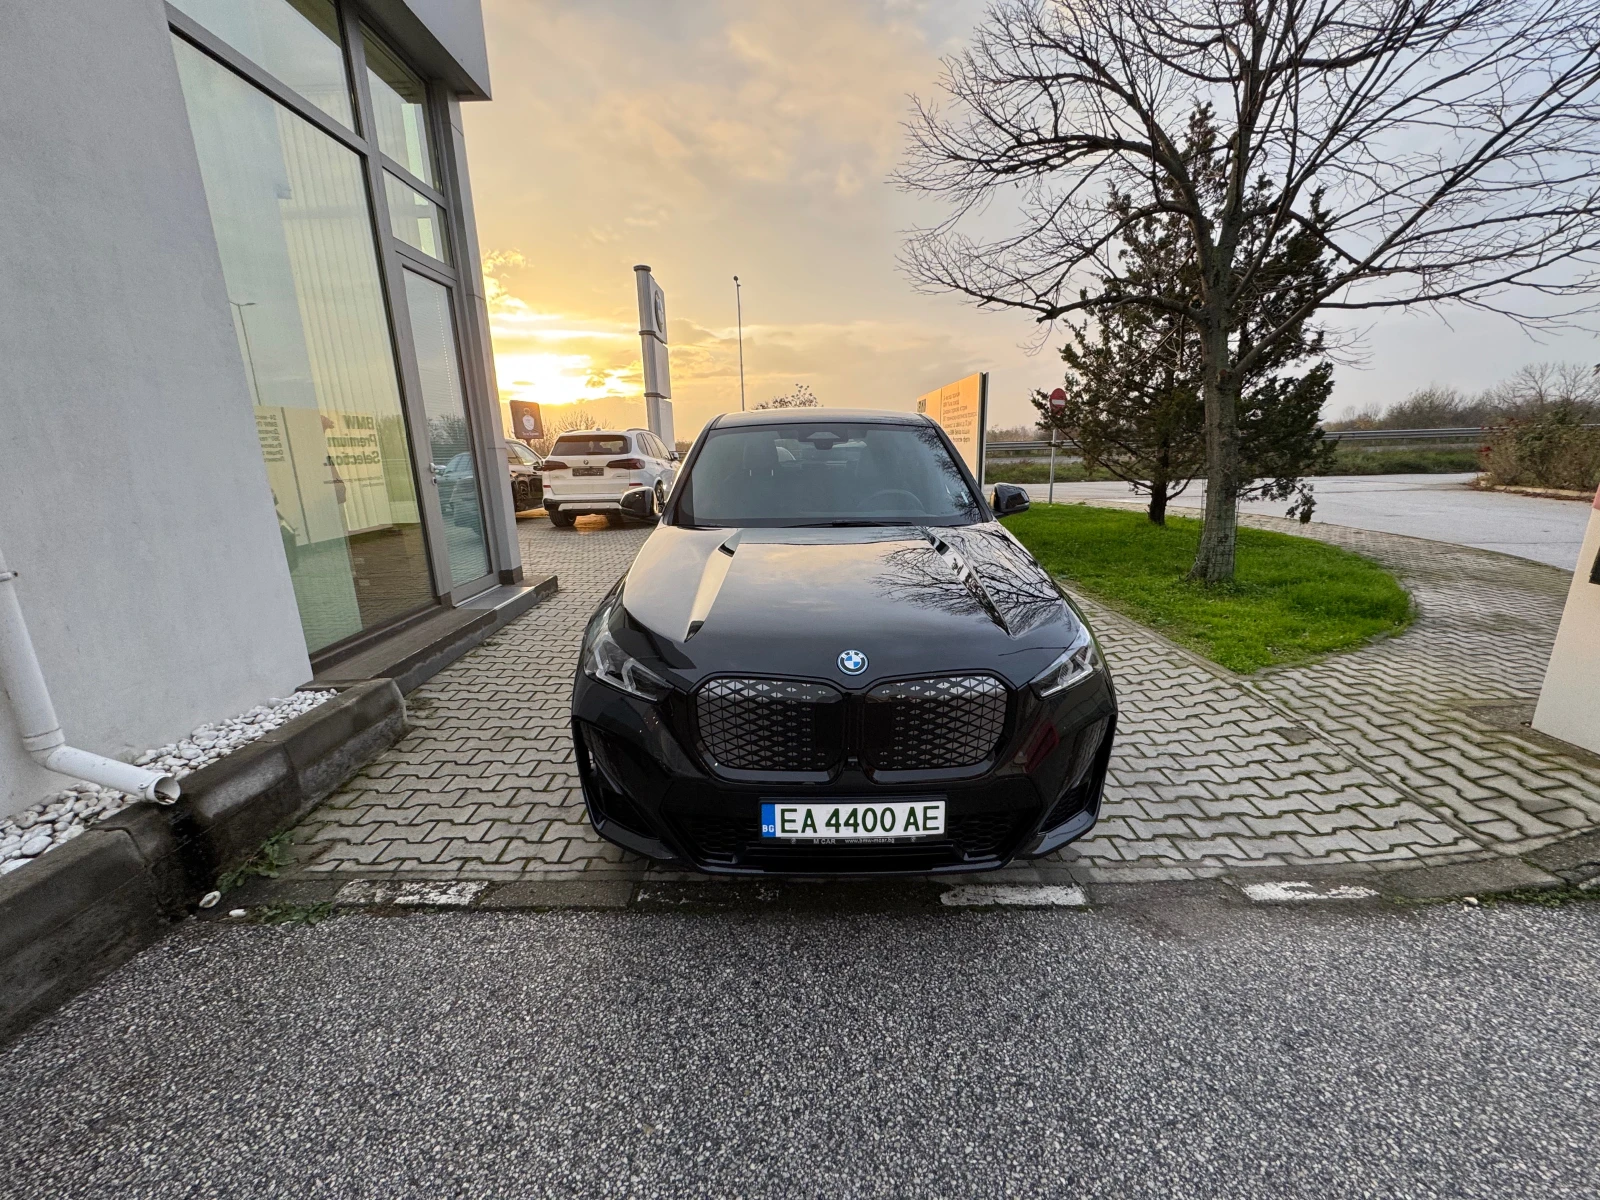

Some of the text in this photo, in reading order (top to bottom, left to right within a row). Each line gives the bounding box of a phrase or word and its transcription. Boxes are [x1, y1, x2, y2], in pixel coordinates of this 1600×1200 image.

[762, 824, 775, 833] BG
[780, 805, 940, 834] EA 4400 AE
